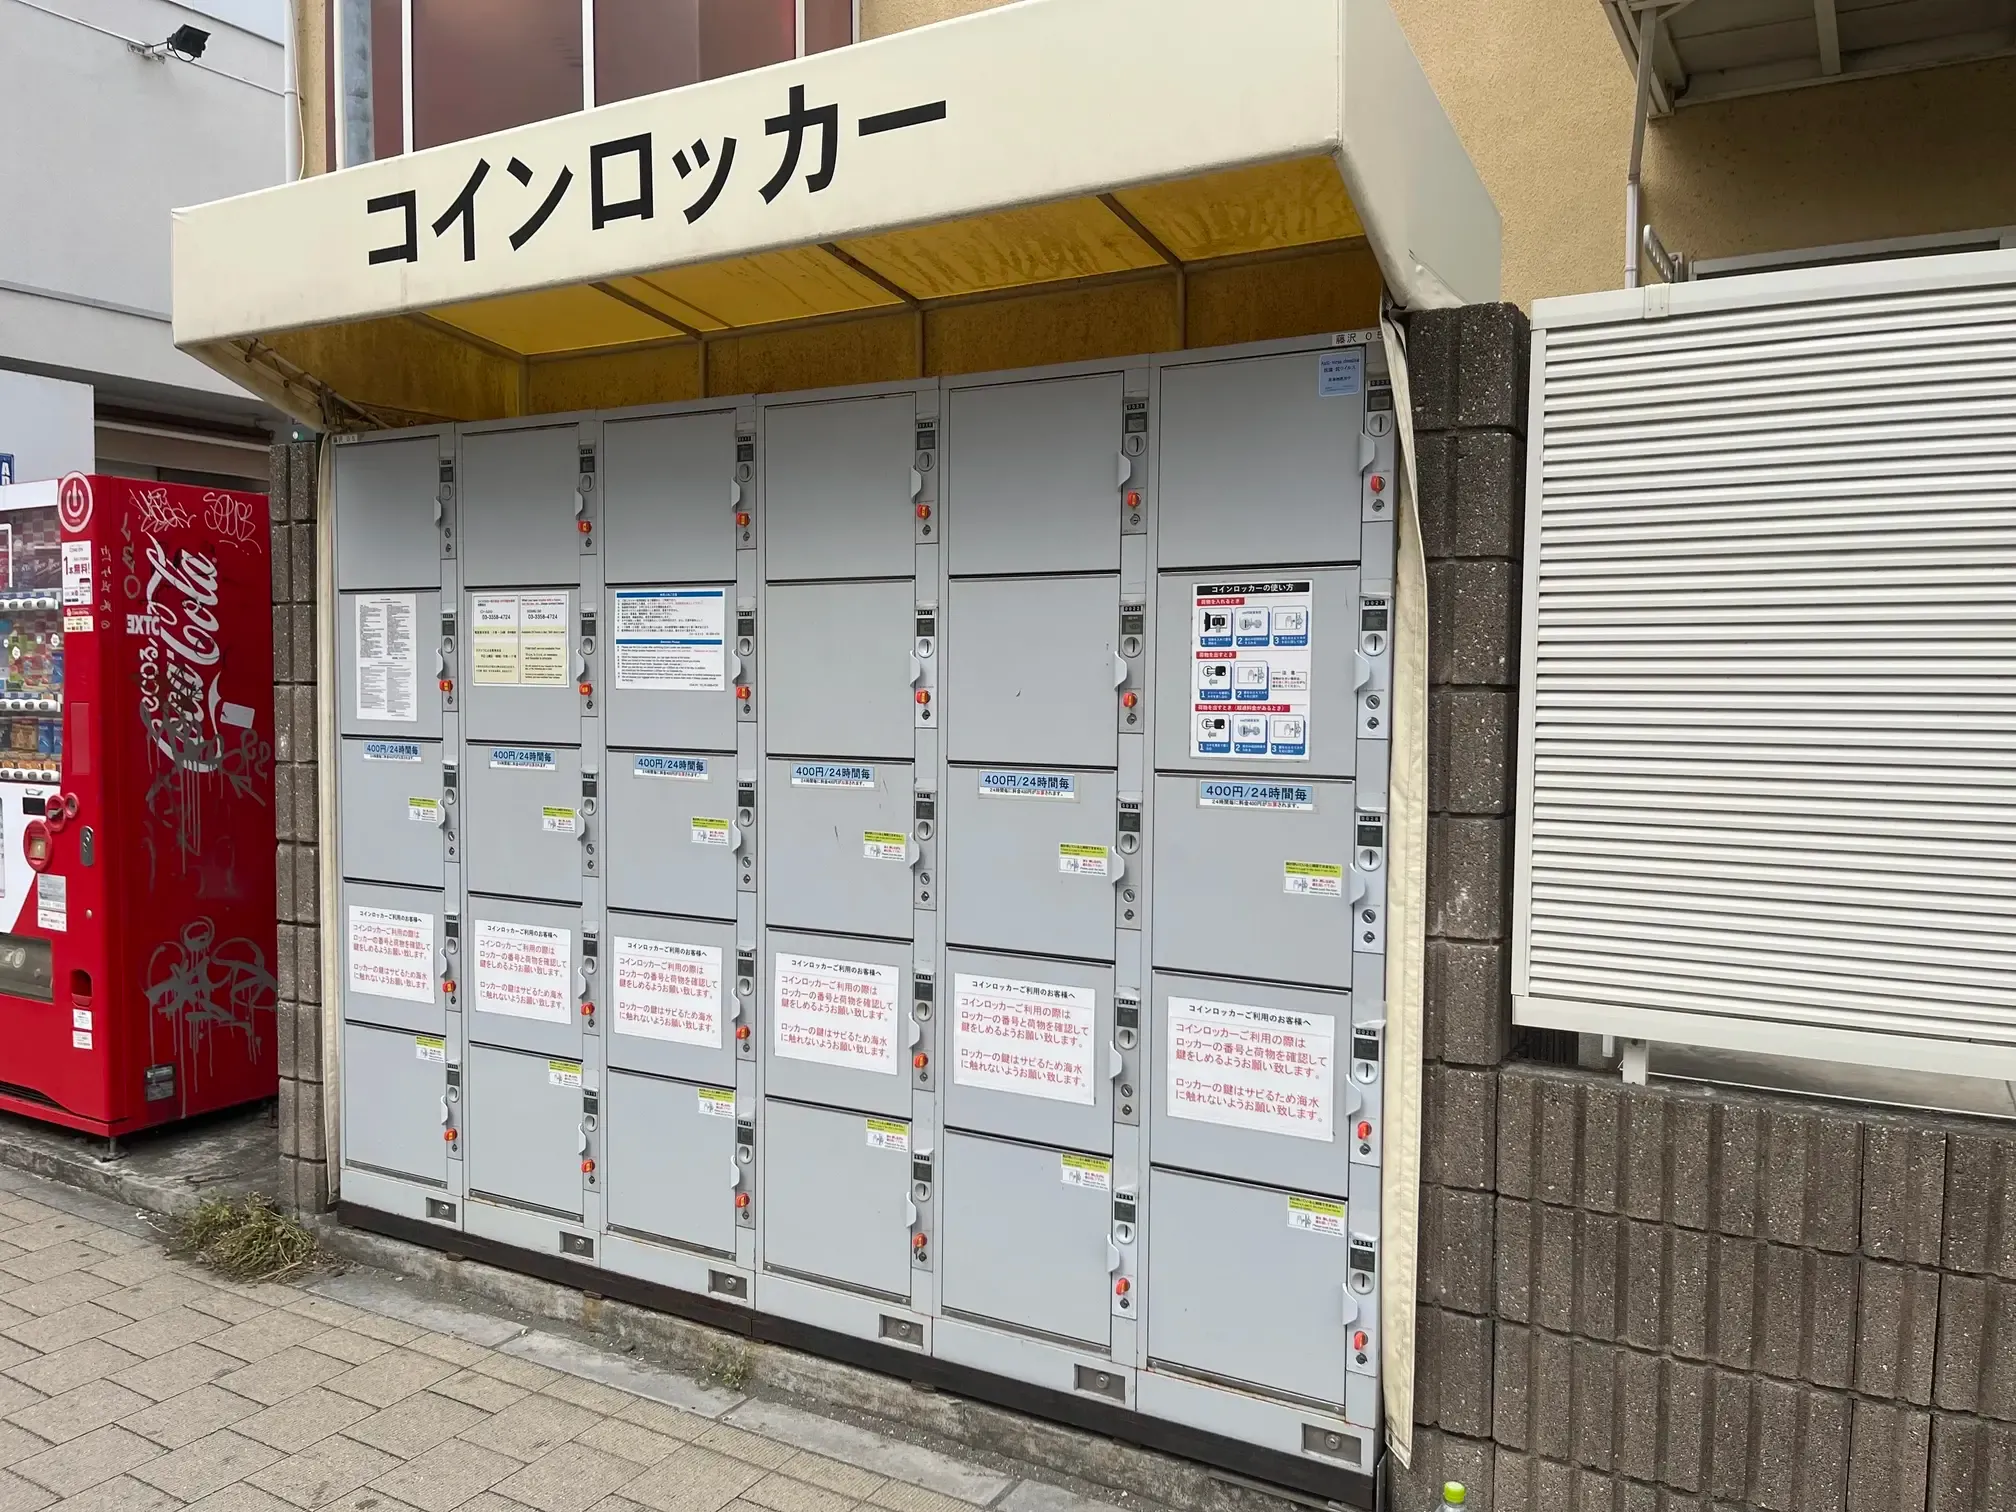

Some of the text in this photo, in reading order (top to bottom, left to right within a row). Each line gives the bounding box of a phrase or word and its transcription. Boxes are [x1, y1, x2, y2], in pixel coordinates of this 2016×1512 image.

[367, 84, 946, 265] コインロッカー
[1211, 584, 1294, 593] コインロッカーの使い方
[1201, 637, 1206, 645] 1
[1237, 637, 1243, 645] 2
[1274, 636, 1280, 644] 3
[1236, 690, 1242, 698] 2
[366, 744, 418, 755] 400円/24時間毎
[493, 750, 552, 762] 400円/24時間毎
[1199, 743, 1204, 751] 1
[1235, 744, 1241, 752] 2
[1271, 745, 1277, 753] 3
[638, 758, 704, 771] 400円/24時間毎
[796, 766, 870, 779] 400円/24時間毎
[984, 774, 1070, 789] 400円/24時間毎
[1206, 786, 1307, 801] 400円/24時間毎
[627, 941, 707, 957] コインロッカーご利用のお客様へ
[619, 956, 703, 974] コインロッカーご利用の際は
[791, 959, 882, 977] コインロッカーご利用のお客様へ
[619, 967, 718, 989] ロッカーの番号と荷物を確認して
[619, 977, 713, 999] 鍵をしめるようお願い致します。
[781, 974, 878, 996] コインロッカーご利用の際は
[971, 979, 1076, 999] コインロッカーご利用のお客様へ
[781, 986, 894, 1011] ロッカーの番号と荷物を確認して
[781, 997, 888, 1021] 鍵をしめるようお願い致します。
[960, 996, 1071, 1020] コインロッカーご利用の際は
[619, 1000, 712, 1022] ロッカーの鍵はサビるため海水
[619, 1010, 715, 1033] に触れないようお願い致します。
[1188, 1003, 1311, 1027] コインロッカーご利用のお客様へ
[780, 1021, 887, 1046] ロッカーの鍵はサビるため海水
[960, 1009, 1090, 1036] ロッカーの番号と荷物を確認して
[780, 1032, 891, 1058] に触れないようお願い致します。
[960, 1021, 1083, 1048] 鍵をしめるようお願い致します。
[1175, 1021, 1305, 1048] コインロッカーご利用の際は
[960, 1047, 1083, 1075] ロッカーの鍵はサビるため海水
[1175, 1035, 1327, 1067] ロッカーの番号と荷物を確認して
[960, 1058, 1087, 1087] に触れないようお願い致します。
[1175, 1048, 1319, 1079] 鍵をしめるようお願い致します。
[1175, 1076, 1319, 1108] ロッカーの鍵はサビるため海水
[1174, 1088, 1323, 1122] に触れないようお願い致します。
